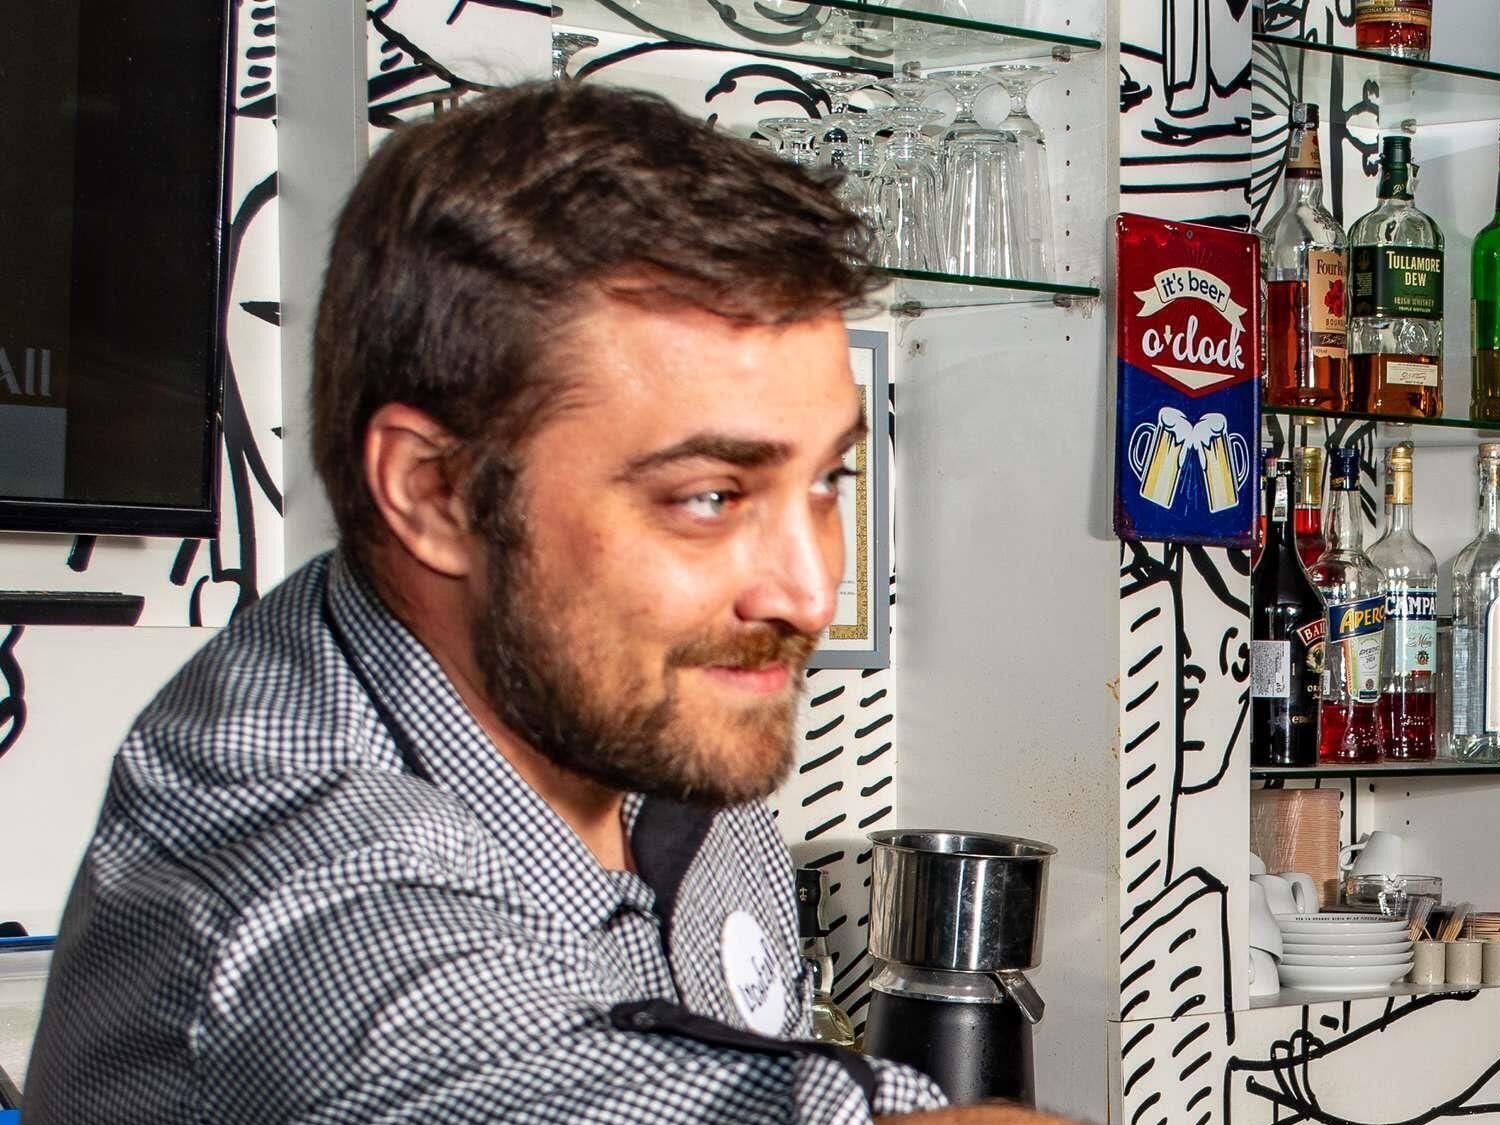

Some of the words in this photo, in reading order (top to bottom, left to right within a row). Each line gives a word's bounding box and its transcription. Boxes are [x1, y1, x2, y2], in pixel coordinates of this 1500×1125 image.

[1386, 250, 1440, 273] TULLAMORE
[1161, 274, 1184, 297] it's
[1188, 270, 1226, 305] beer
[1404, 273, 1427, 289] DEW
[1141, 315, 1245, 370] o'clock
